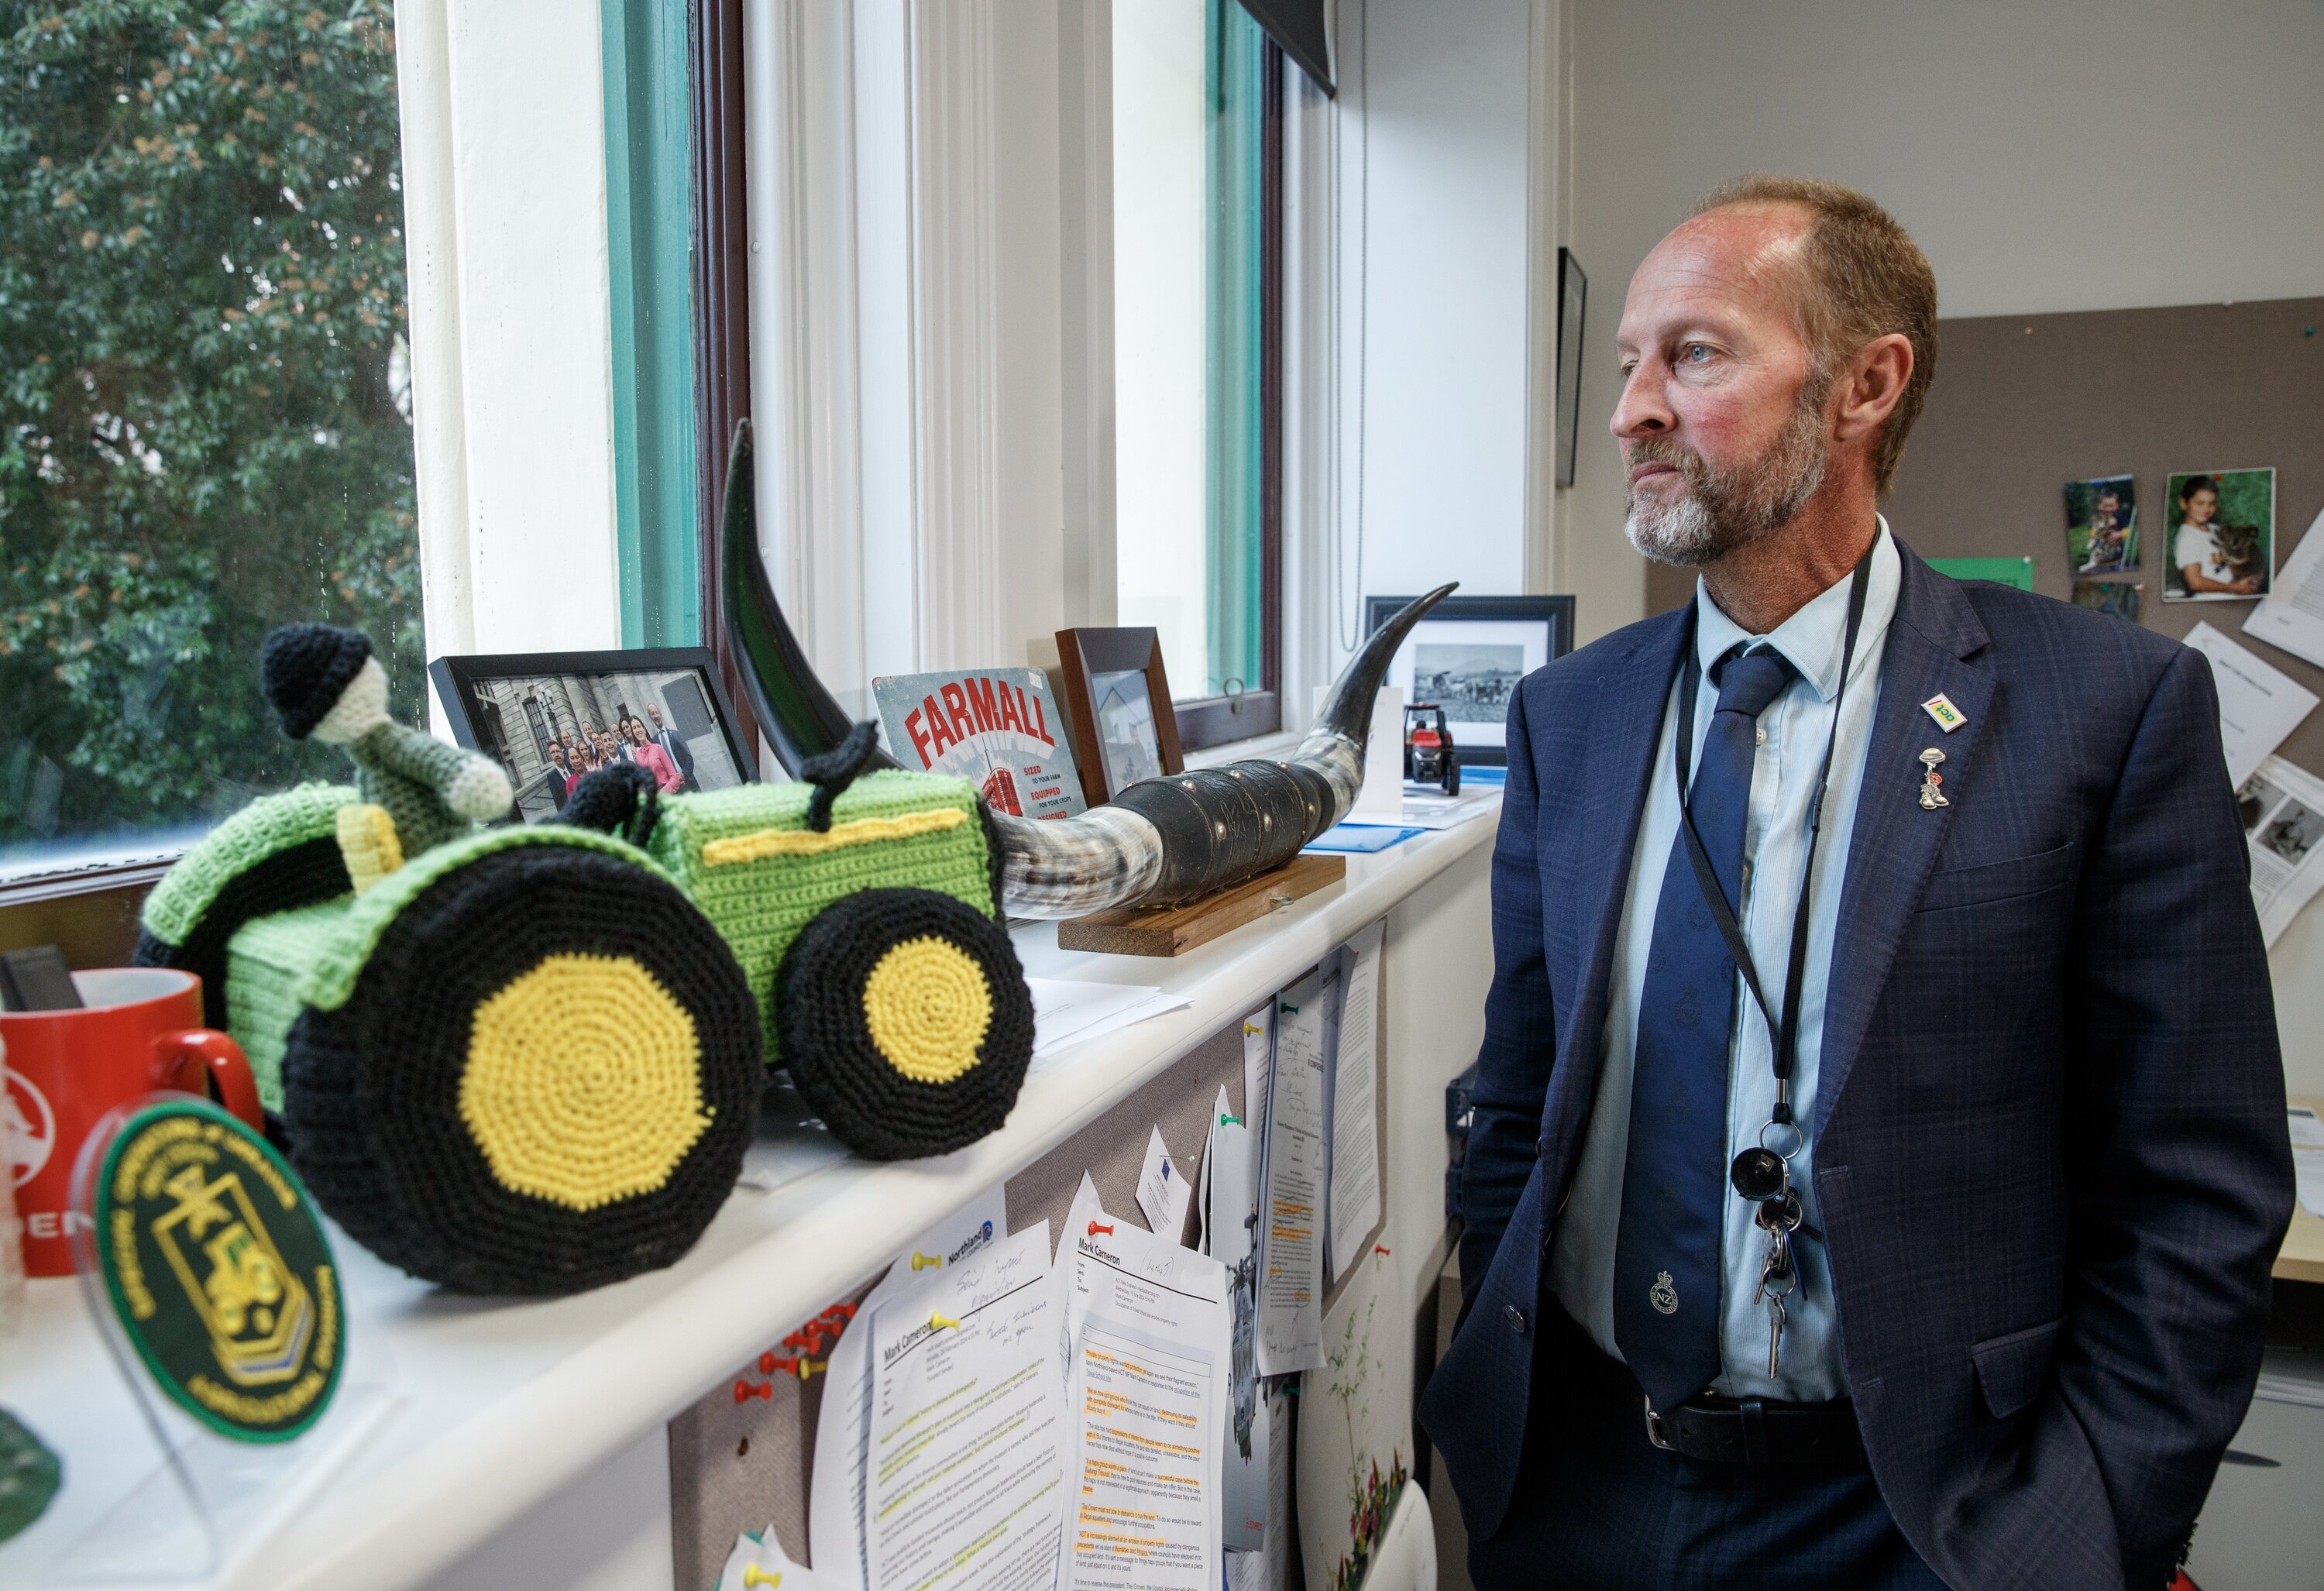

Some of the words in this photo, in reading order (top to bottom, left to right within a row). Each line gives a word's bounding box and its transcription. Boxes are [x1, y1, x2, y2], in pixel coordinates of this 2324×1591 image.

[1936, 704, 1955, 721] act
[905, 677, 1055, 771] FARMALL
[1023, 765, 1041, 775] SIZED
[1031, 787, 1061, 801] EQUIPPED
[948, 1227, 982, 1266] Northland
[1078, 1237, 1094, 1253] Mark
[1095, 1245, 1120, 1266] Cameron
[1122, 1294, 1133, 1304] Cameron
[1655, 1291, 1672, 1304] NZ
[885, 1342, 901, 1363] Mark
[902, 1322, 932, 1349] Cameron
